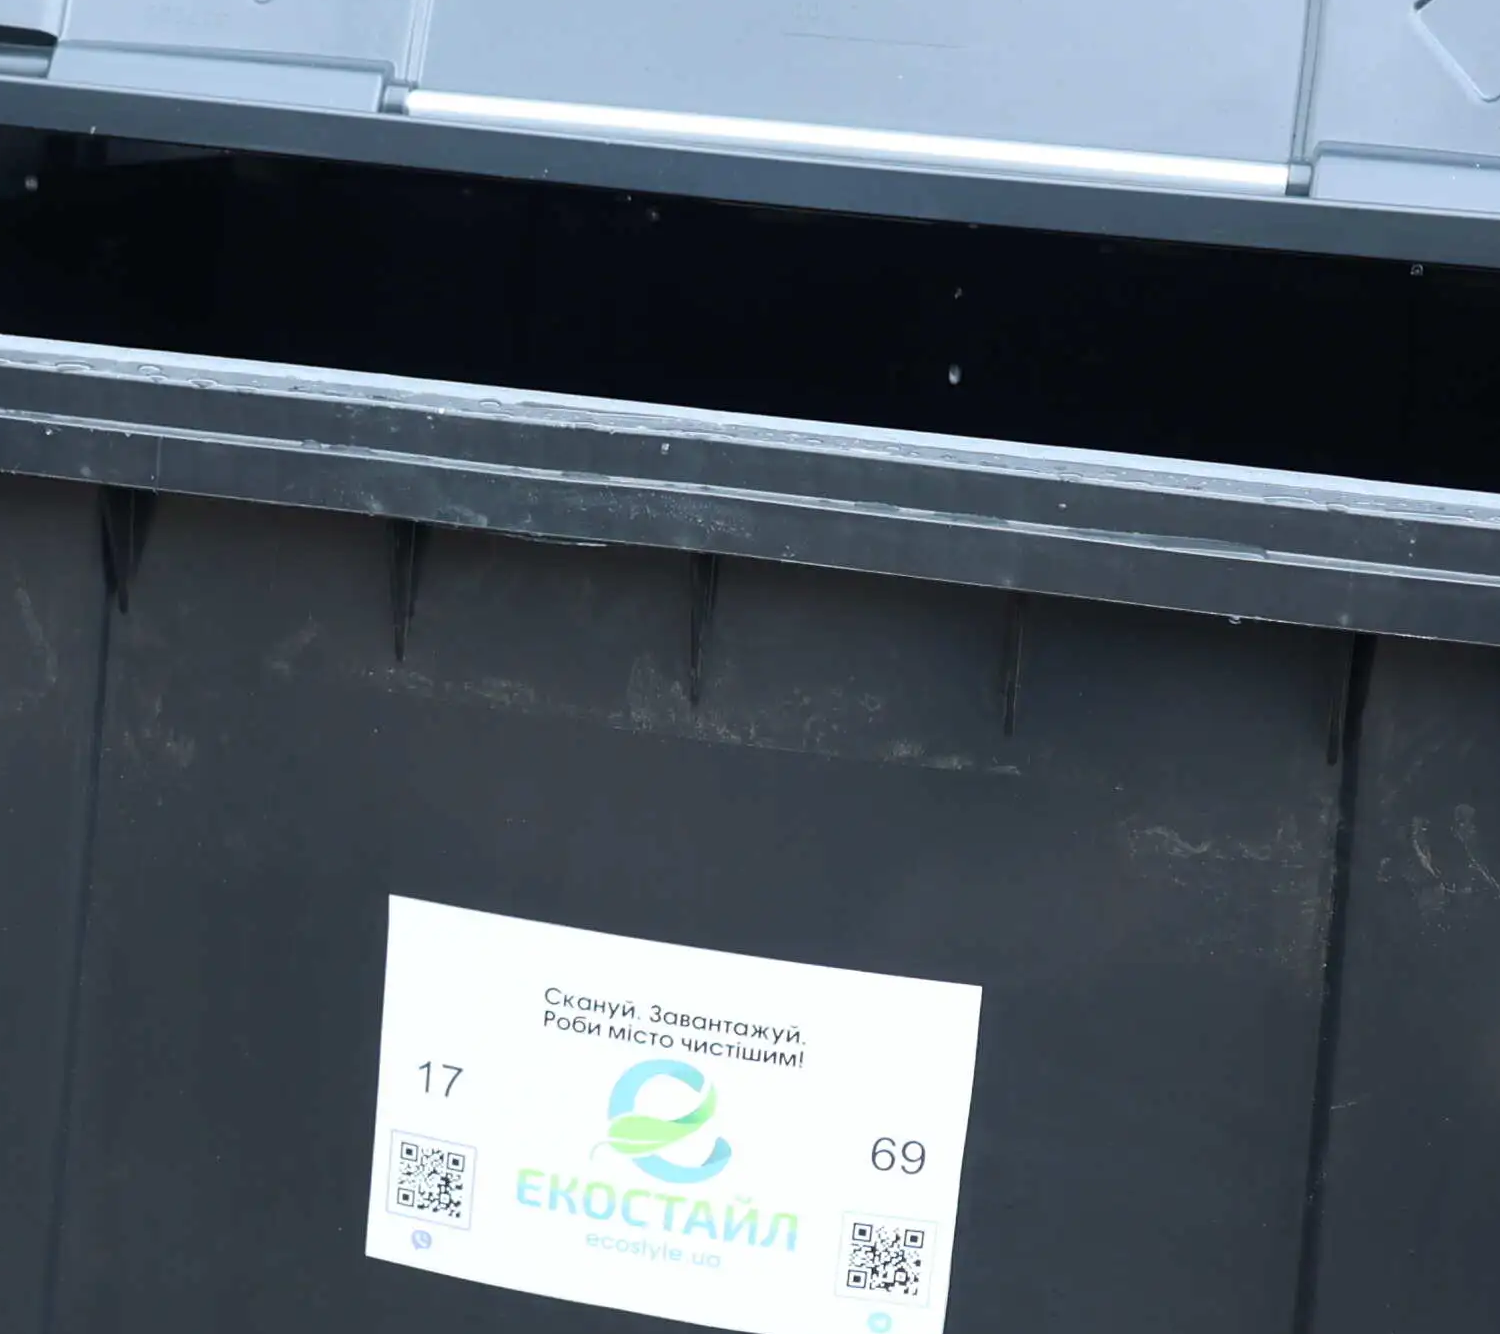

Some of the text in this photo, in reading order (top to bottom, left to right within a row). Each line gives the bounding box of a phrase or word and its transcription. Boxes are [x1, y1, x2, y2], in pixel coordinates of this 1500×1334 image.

[543, 987, 806, 1045] Скануй. Завантажуй.
[543, 1009, 805, 1068] Роби місто чистішим!
[418, 1060, 464, 1098] 17
[871, 1136, 927, 1175] 69
[515, 1167, 799, 1253] ЕКОСТАЙЛ
[585, 1232, 722, 1269] ecostyle.ua
